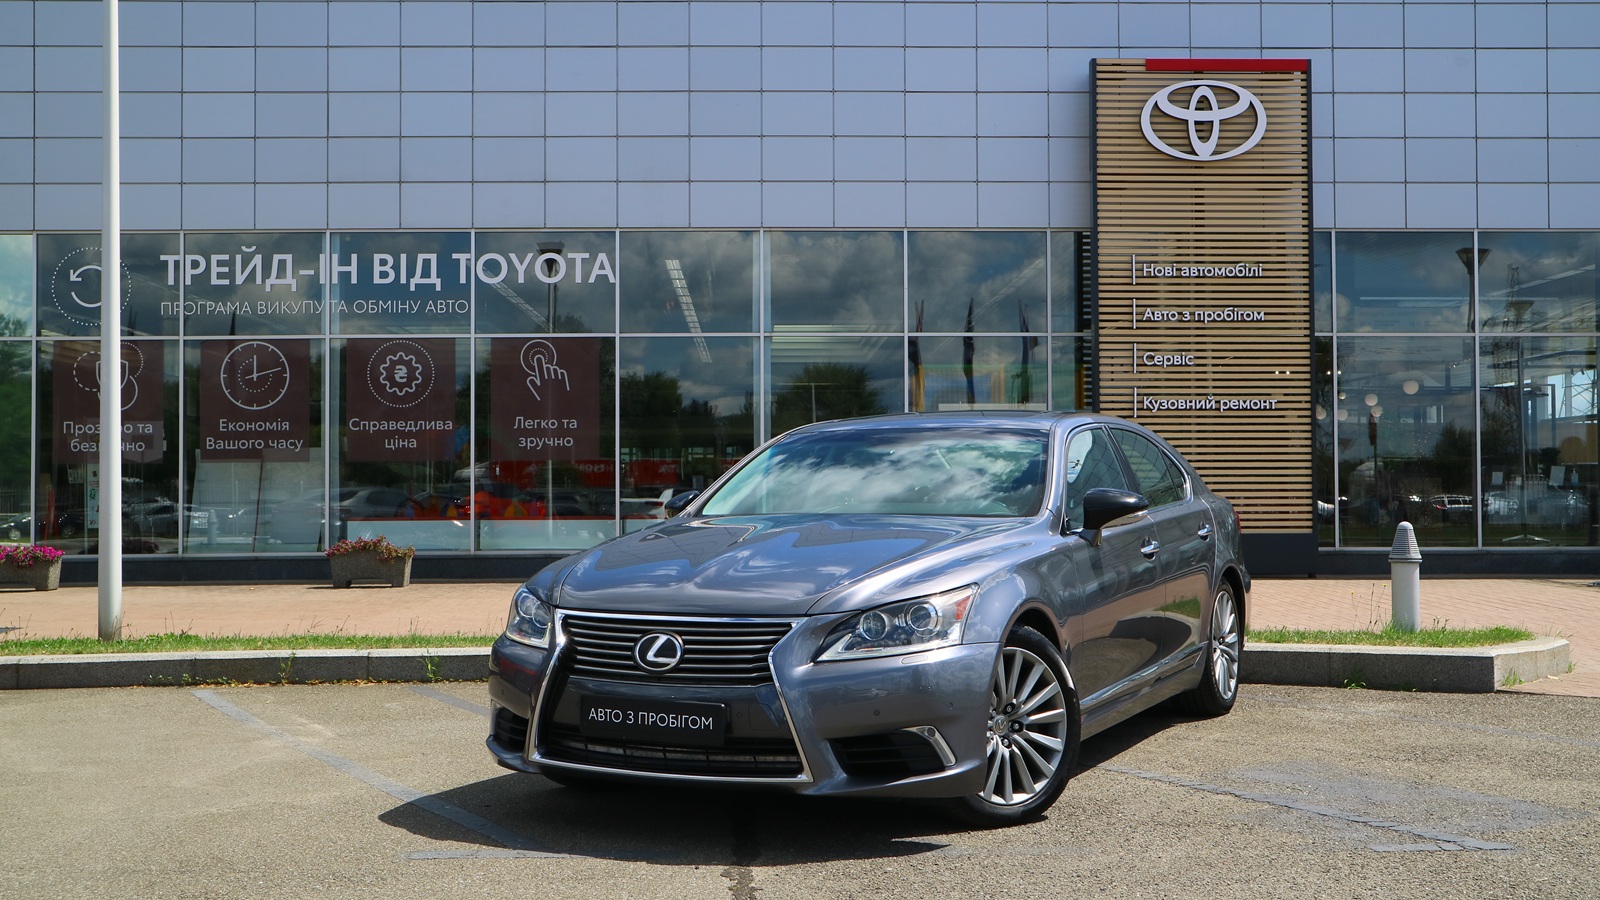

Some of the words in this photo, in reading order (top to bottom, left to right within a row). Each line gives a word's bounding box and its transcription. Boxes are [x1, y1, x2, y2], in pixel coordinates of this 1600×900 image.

[160, 246, 358, 292] ТРЕЙД-ІН
[373, 253, 441, 291] ВІД
[452, 253, 616, 284] TOYOTA
[1143, 263, 1177, 277] Нові
[1181, 263, 1263, 277] автомобілі
[160, 301, 252, 316] ПРОГРАМА
[257, 301, 326, 315] ВИКУПУ
[329, 300, 349, 314] ТА
[353, 300, 421, 314] ОБМІНУ
[425, 300, 469, 314] АВТО
[1143, 308, 1178, 321] Авто
[1182, 311, 1190, 321] з
[1194, 307, 1265, 324] пробігом
[1143, 352, 1194, 368] Сервіс
[1143, 396, 1216, 413] Кузовний
[1220, 399, 1277, 413] ремонт
[63, 421, 133, 437] Прозо
[137, 423, 153, 434] та
[219, 418, 290, 432] Економія
[349, 418, 453, 432] Справедлива
[513, 416, 558, 430] Легко
[562, 418, 578, 429] та
[70, 438, 146, 453] безно
[206, 437, 264, 450] Вашого
[269, 438, 303, 452] часу
[384, 436, 417, 450] ціна
[518, 436, 573, 450] зручно
[588, 708, 622, 723] АВТО
[638, 711, 713, 730] ПРОБІГОМ
